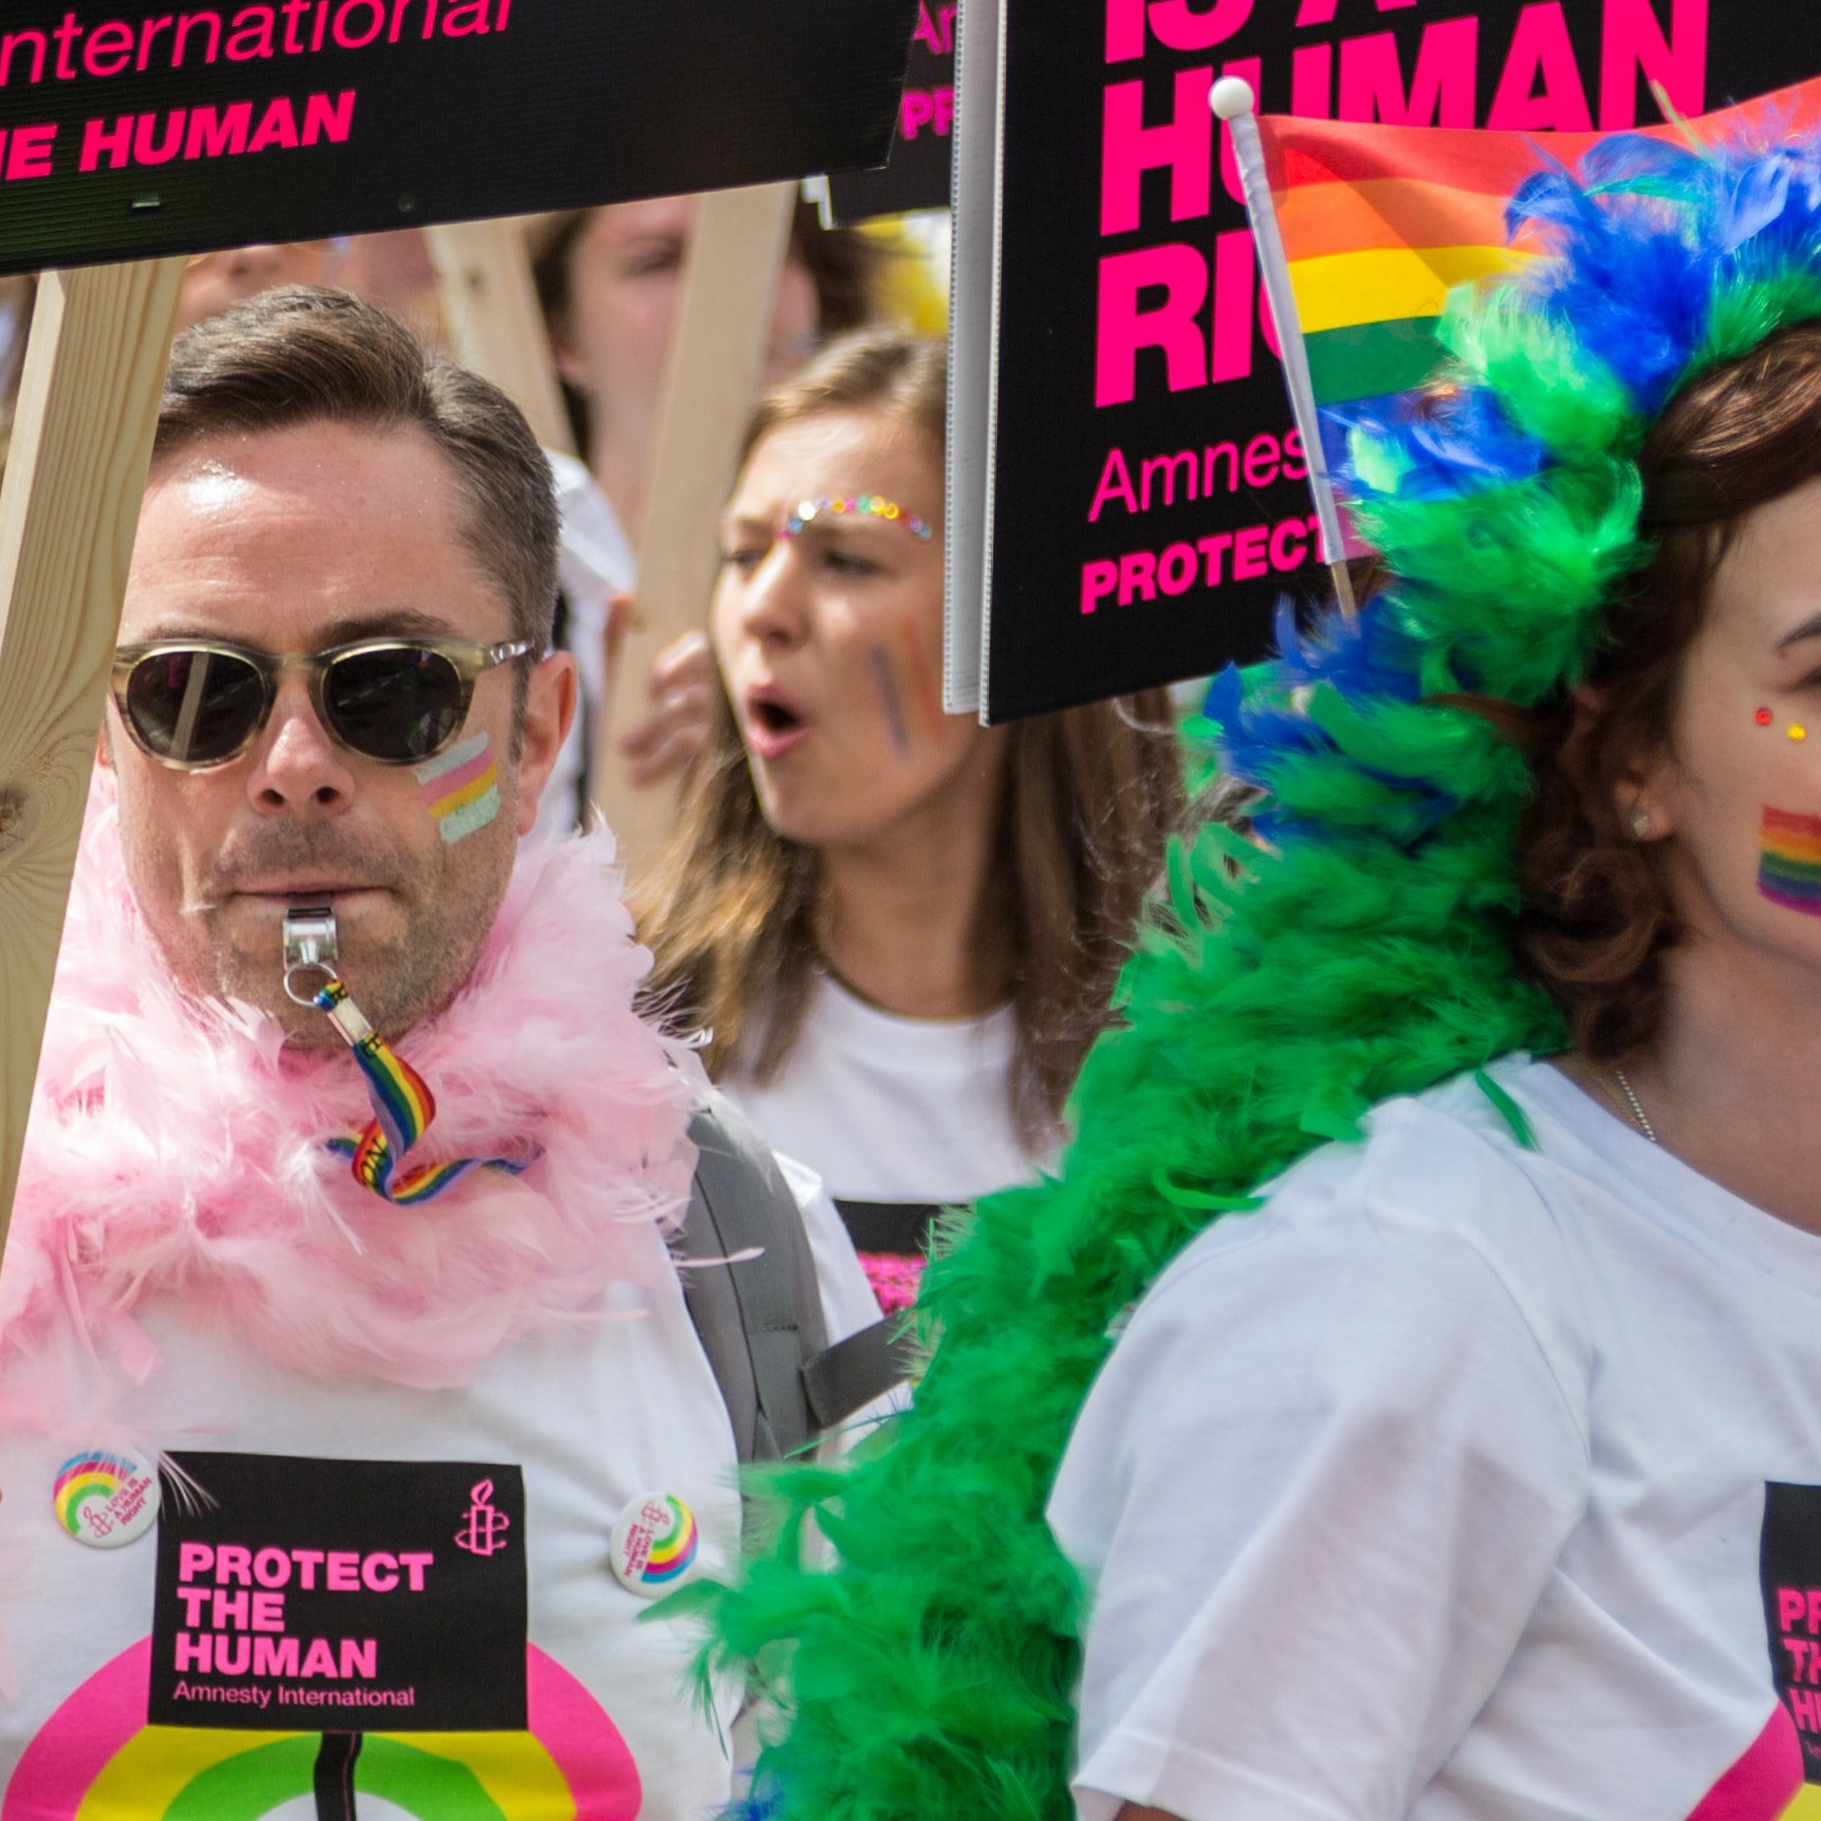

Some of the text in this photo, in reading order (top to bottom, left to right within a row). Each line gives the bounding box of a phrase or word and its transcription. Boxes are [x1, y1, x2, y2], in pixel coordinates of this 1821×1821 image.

[77, 89, 356, 172] HUMAN
[1087, 426, 1310, 522] Amnes
[178, 1542, 434, 1594] PROTECT
[177, 1587, 285, 1633] THE
[174, 1631, 377, 1680] HUMAN
[172, 1681, 416, 1710] Amnesty International
